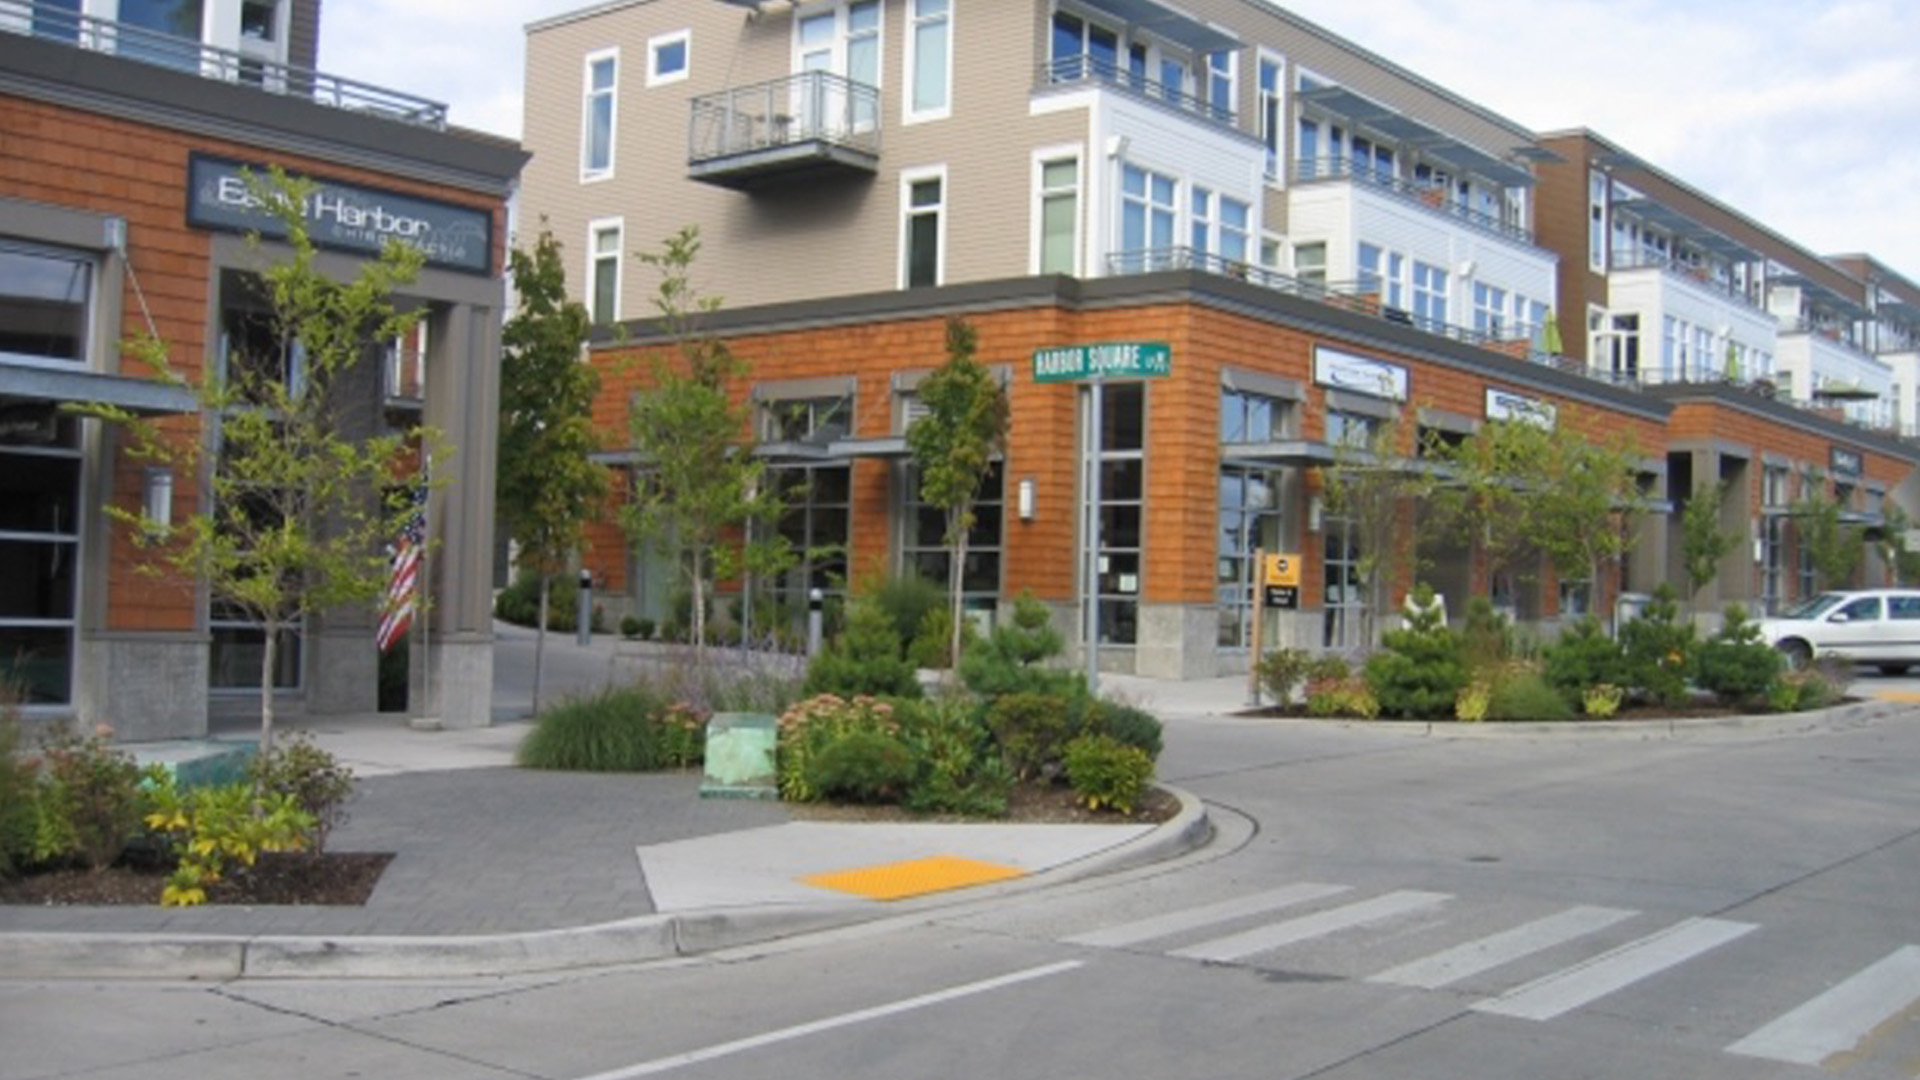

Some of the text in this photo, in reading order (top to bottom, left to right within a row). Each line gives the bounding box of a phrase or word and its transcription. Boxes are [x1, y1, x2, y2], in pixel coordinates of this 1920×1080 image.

[315, 193, 430, 236] Harbor
[1036, 349, 1083, 375] HARBOR
[1089, 345, 1140, 370] SQUARE
